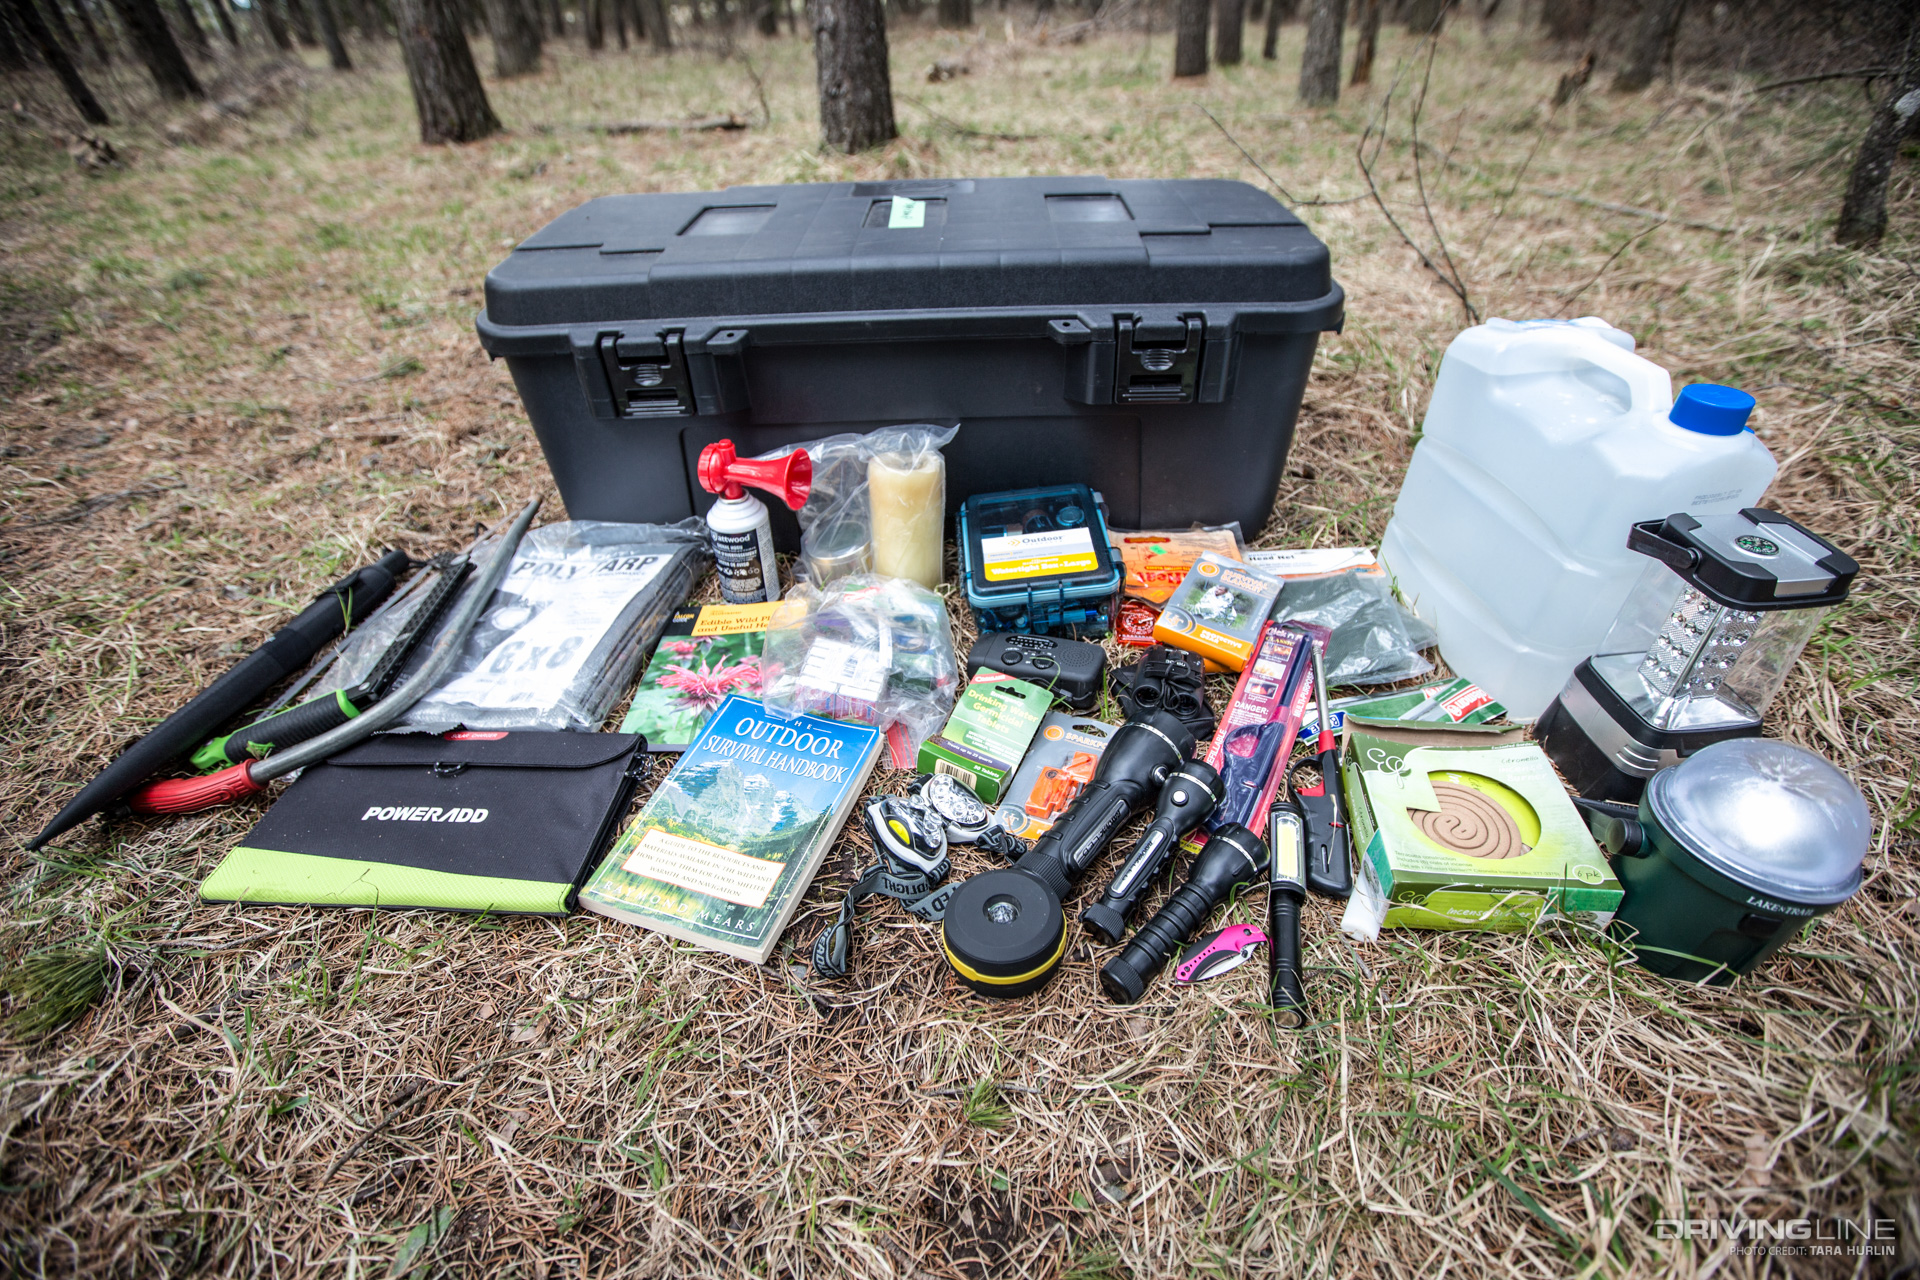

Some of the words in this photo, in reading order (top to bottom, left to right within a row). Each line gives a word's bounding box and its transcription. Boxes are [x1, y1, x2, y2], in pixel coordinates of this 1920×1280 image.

[717, 533, 751, 543] attwood
[1022, 535, 1064, 544] Outdoor
[512, 561, 586, 579] POLY
[991, 563, 1039, 575] Watertight
[1041, 560, 1059, 570] Box
[1064, 559, 1092, 569] Large
[1220, 574, 1263, 594] BLANKET
[1223, 569, 1268, 590] SURVIVAL
[697, 625, 718, 633] and
[721, 623, 753, 632] Useful
[700, 618, 732, 627] Edible
[736, 616, 758, 624] Wild
[1201, 630, 1242, 648] PROTECTIVE
[1265, 636, 1296, 646] CLASSIC
[968, 689, 1008, 711] Drinking
[1010, 705, 1038, 723] Water
[990, 690, 1024, 706] Emergency
[973, 702, 1024, 728] Germicidal
[1234, 700, 1269, 715] DANGER:
[785, 719, 812, 730] THE
[977, 714, 1009, 734] Tablets
[735, 717, 844, 759] OUTDOOR
[703, 735, 764, 765] SURVIVAL
[764, 751, 849, 784] HANDBOOK
[1501, 755, 1539, 764] Citronella
[981, 767, 999, 778] Tablets
[361, 806, 489, 823] POWERADD
[636, 851, 654, 862] HOW
[665, 859, 677, 868] USE
[678, 863, 698, 874] THEM
[698, 869, 713, 878] FOR
[643, 843, 678, 857] MATERIALS
[679, 853, 711, 867] AVAILABLE
[722, 866, 735, 874] THE
[736, 870, 756, 880] WILD
[756, 874, 773, 883] AND
[664, 840, 686, 849] GUIDE
[698, 848, 711, 857] THE
[712, 851, 750, 868] RESOURCES
[751, 863, 767, 871] AND
[650, 866, 680, 878] WARMTH
[681, 875, 698, 884] AND
[698, 880, 741, 897] NAVIGATION
[1585, 871, 1600, 879] pk
[603, 880, 689, 914] RAYMOND
[697, 911, 755, 932] MEARS
